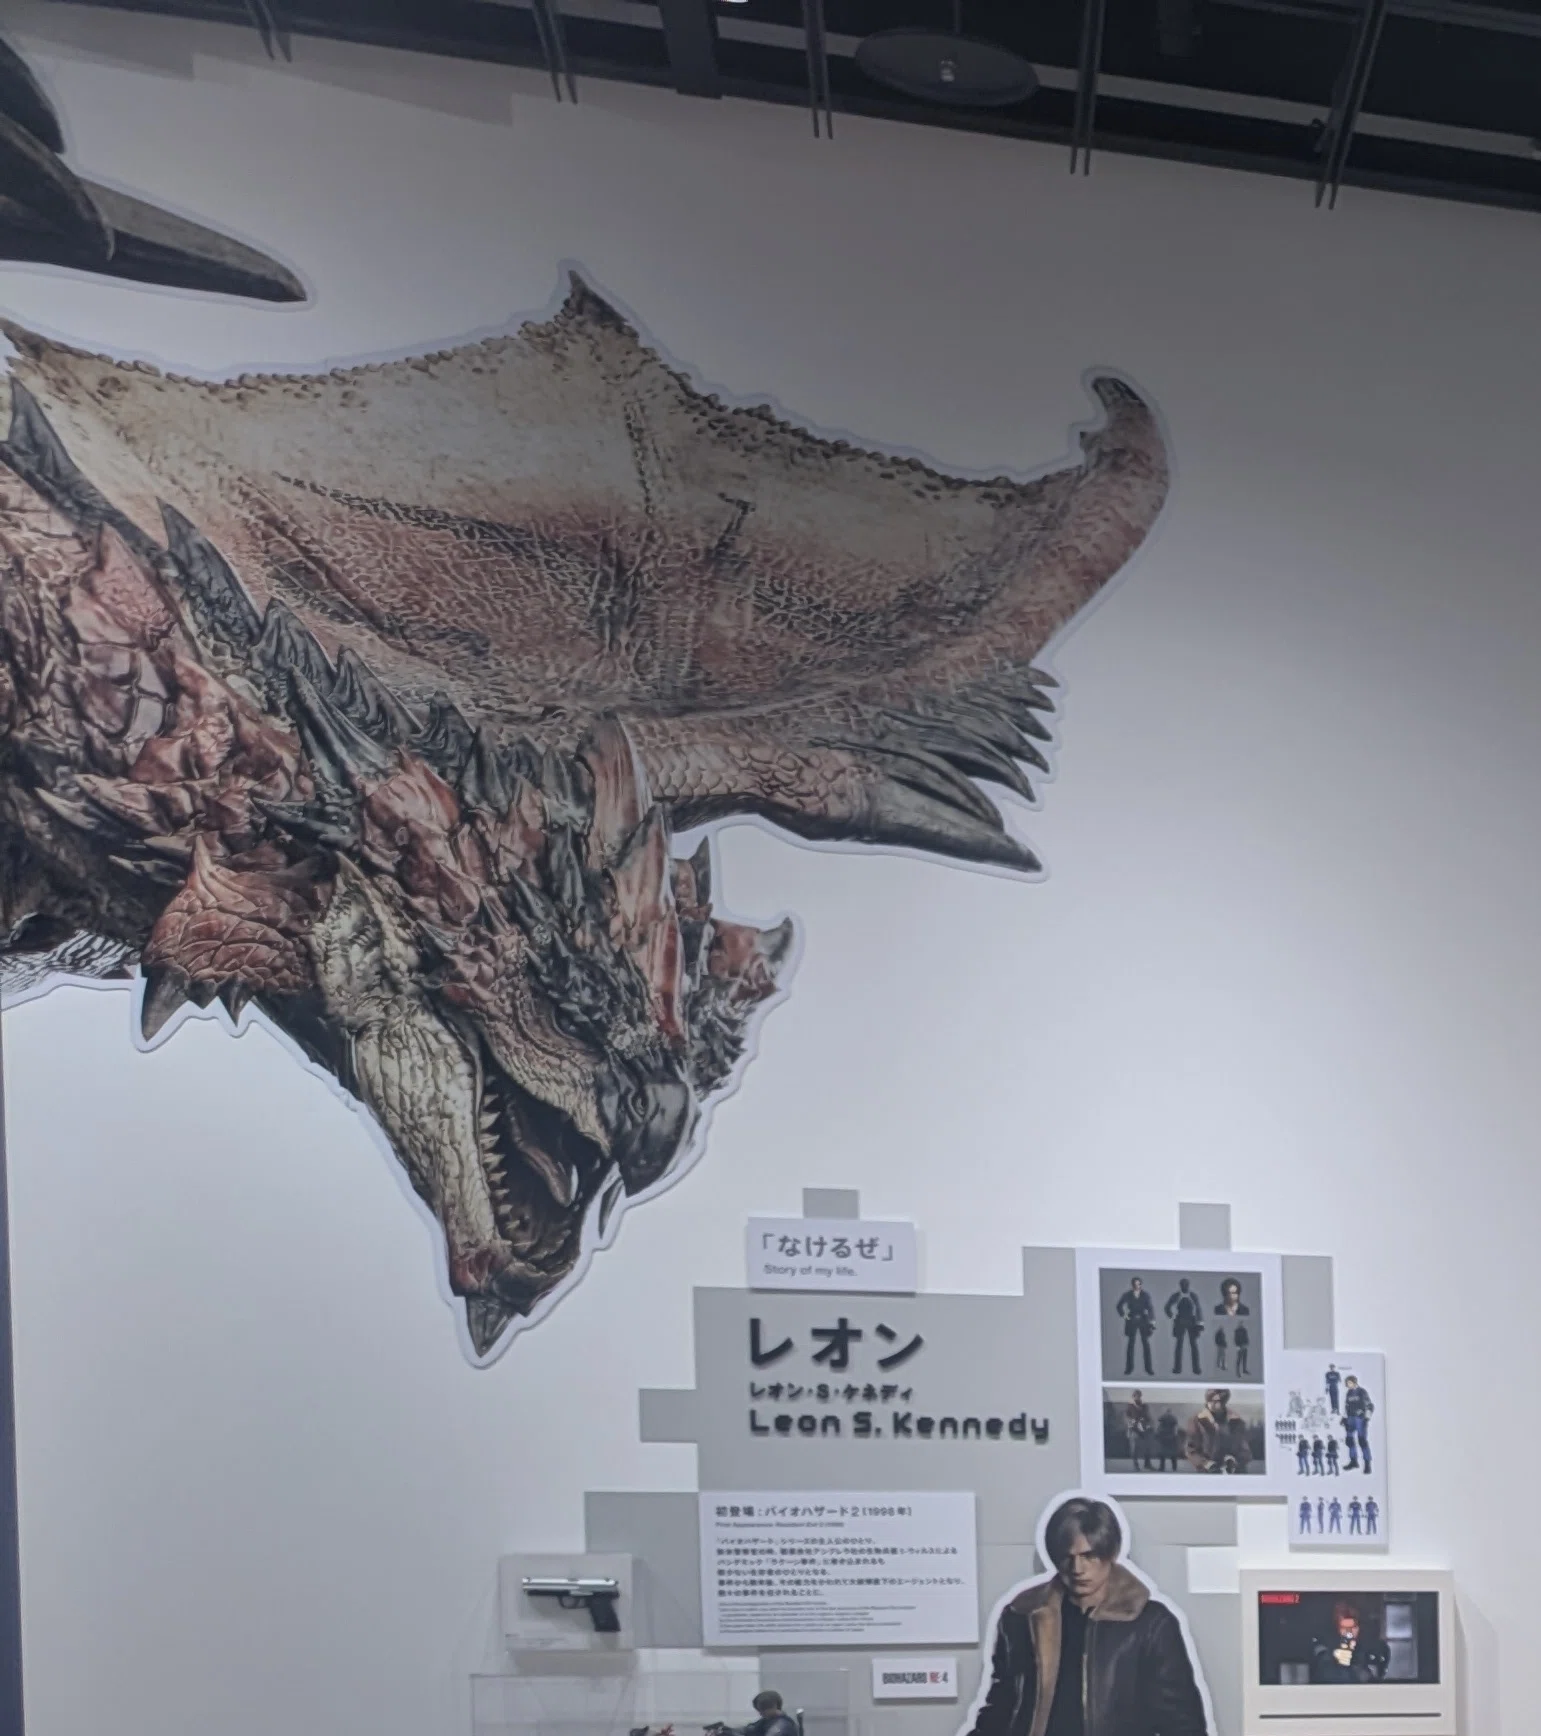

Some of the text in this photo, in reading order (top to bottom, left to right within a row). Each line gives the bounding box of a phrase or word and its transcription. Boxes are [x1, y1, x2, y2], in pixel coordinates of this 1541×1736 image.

[762, 1232, 893, 1261] 「なけるぜ」
[750, 1317, 925, 1369] レオン
[750, 1382, 913, 1402] レオン・S・ケネディ
[750, 1409, 1049, 1444] Leon S. Kennedy
